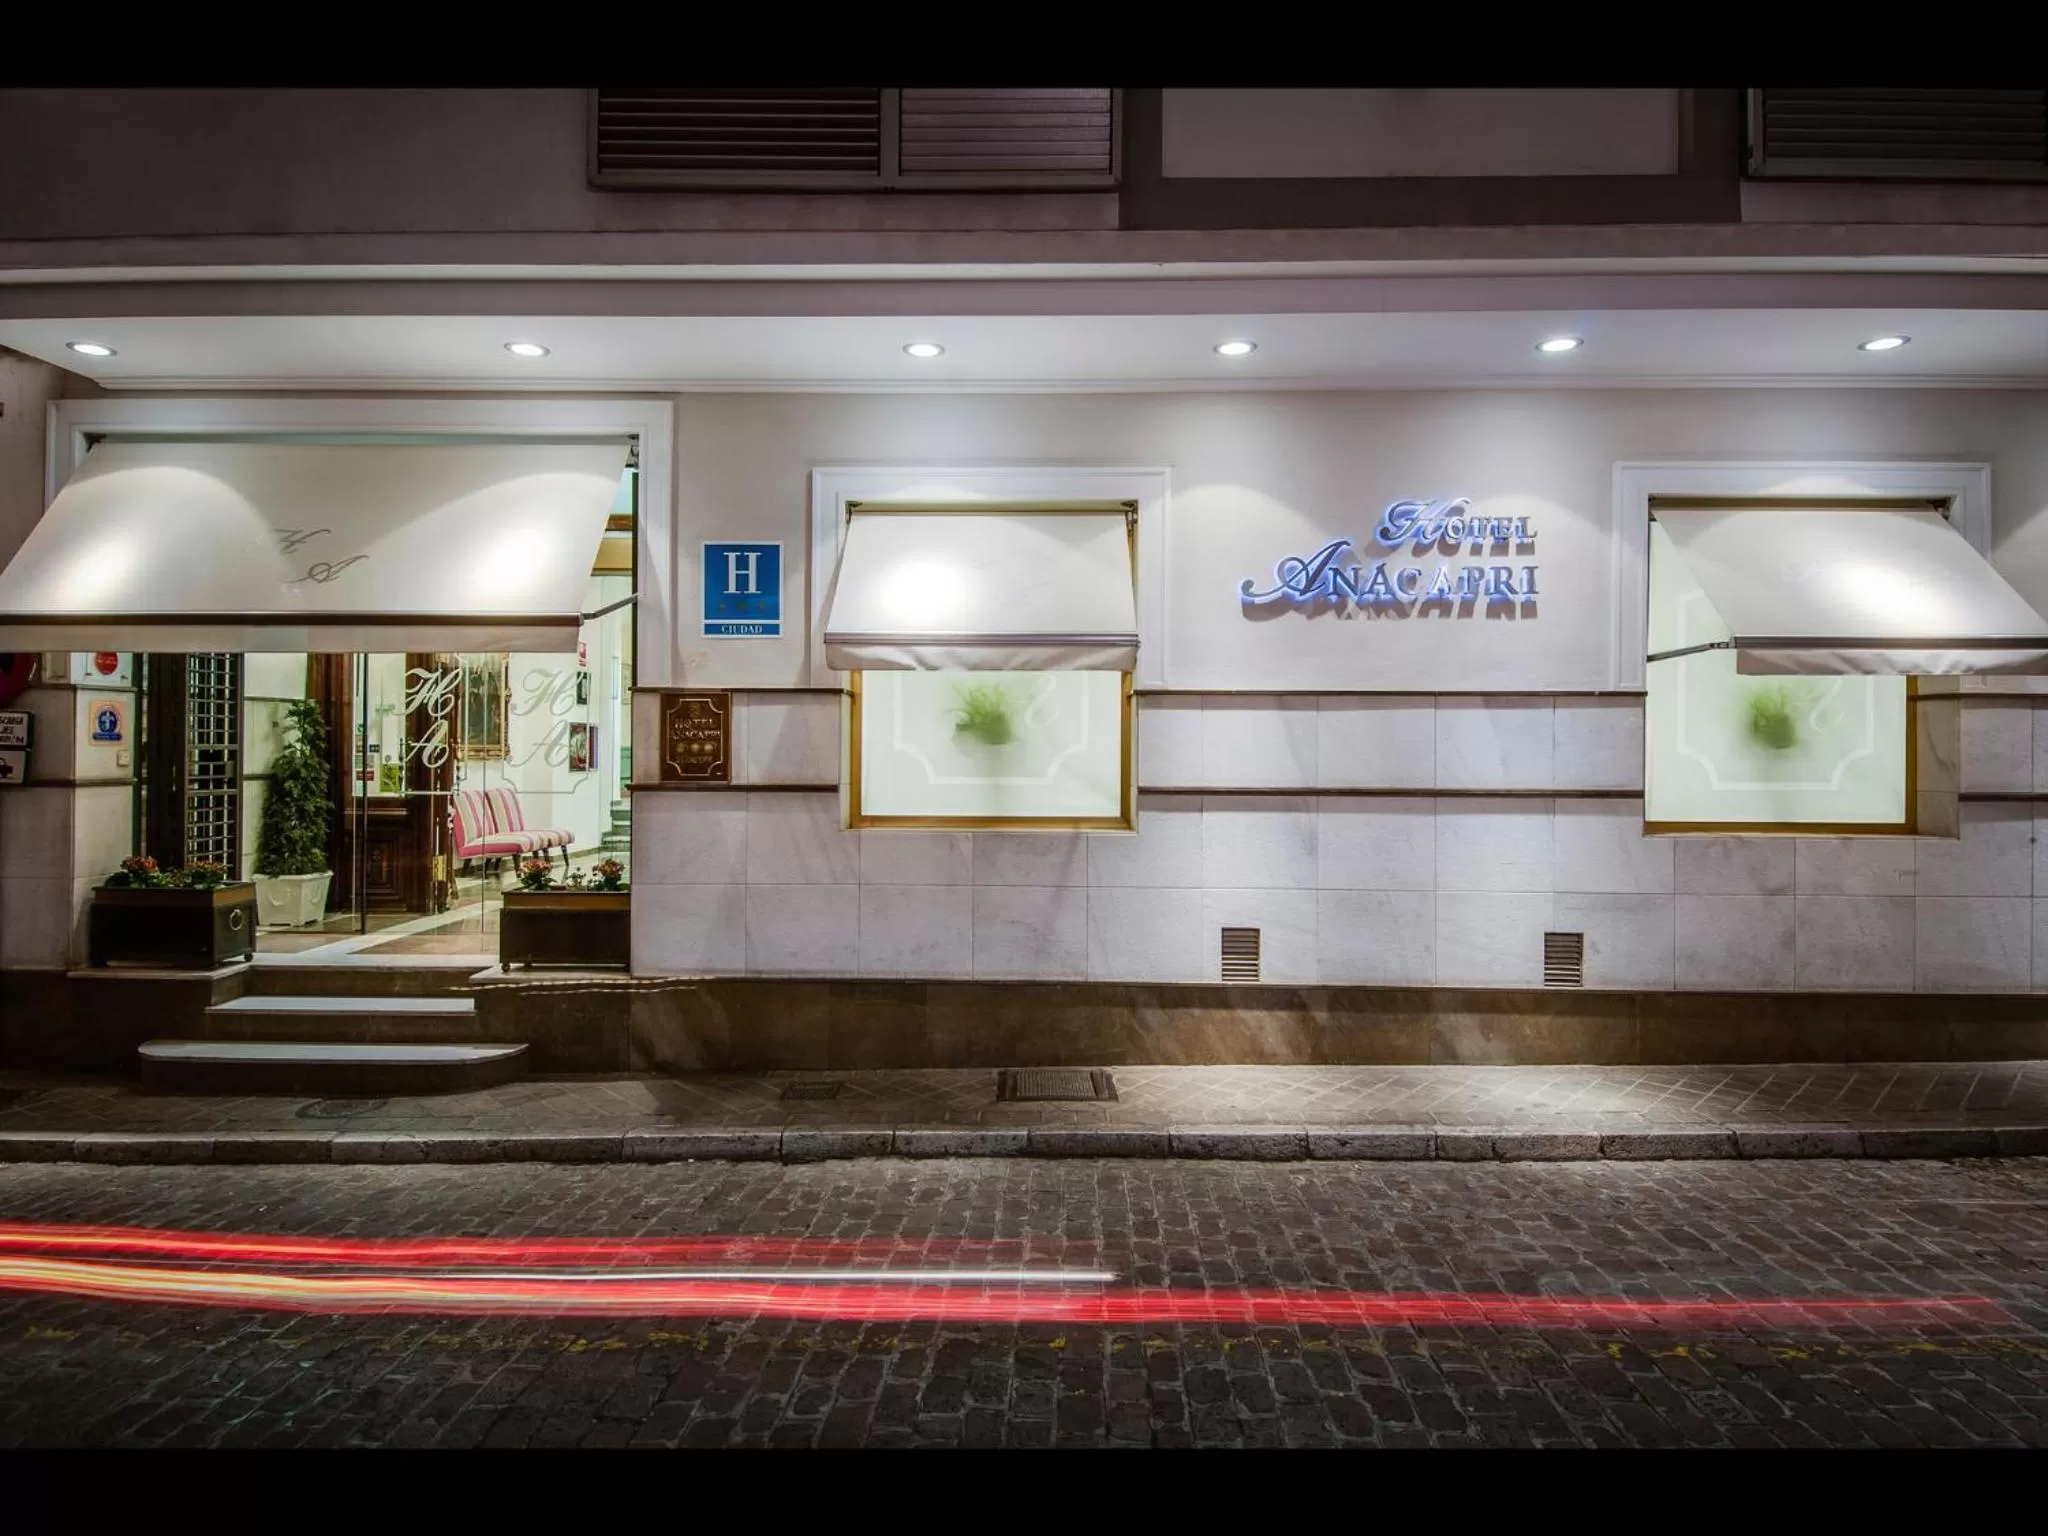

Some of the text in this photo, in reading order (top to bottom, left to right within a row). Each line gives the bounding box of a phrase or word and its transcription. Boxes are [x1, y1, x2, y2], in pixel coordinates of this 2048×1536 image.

[1379, 497, 1538, 541] HOTEL
[723, 552, 762, 594] H
[1241, 540, 1539, 598] ANACAPRI
[721, 625, 763, 636] CIUDAD
